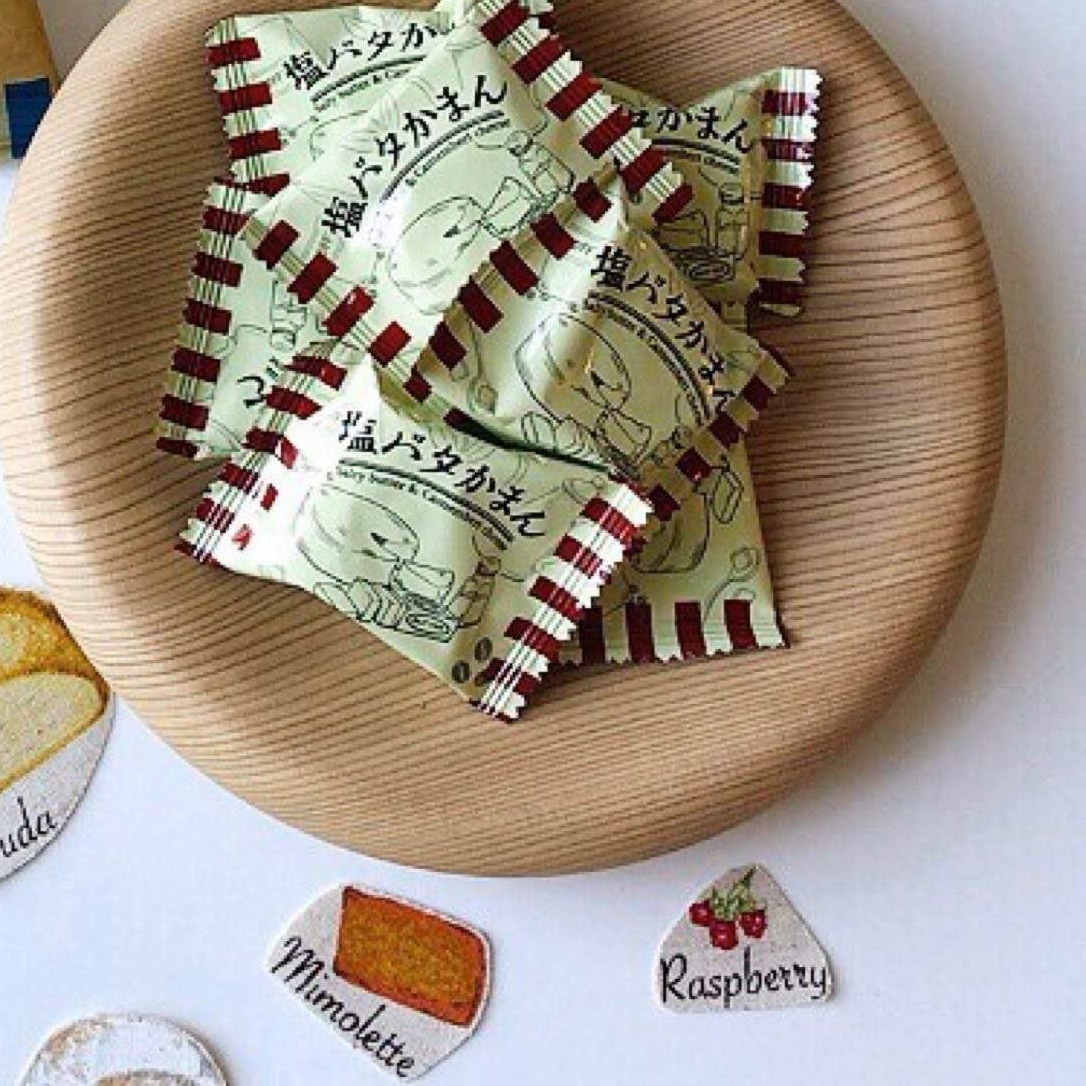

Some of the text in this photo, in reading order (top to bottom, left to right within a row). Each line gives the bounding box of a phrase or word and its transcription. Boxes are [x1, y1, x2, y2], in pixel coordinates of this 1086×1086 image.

[320, 74, 509, 239] 塩バタかまん
[338, 410, 547, 538] 塩バタかまん
[269, 934, 415, 1079] Mimolette
[658, 946, 830, 1008] Raspberry
